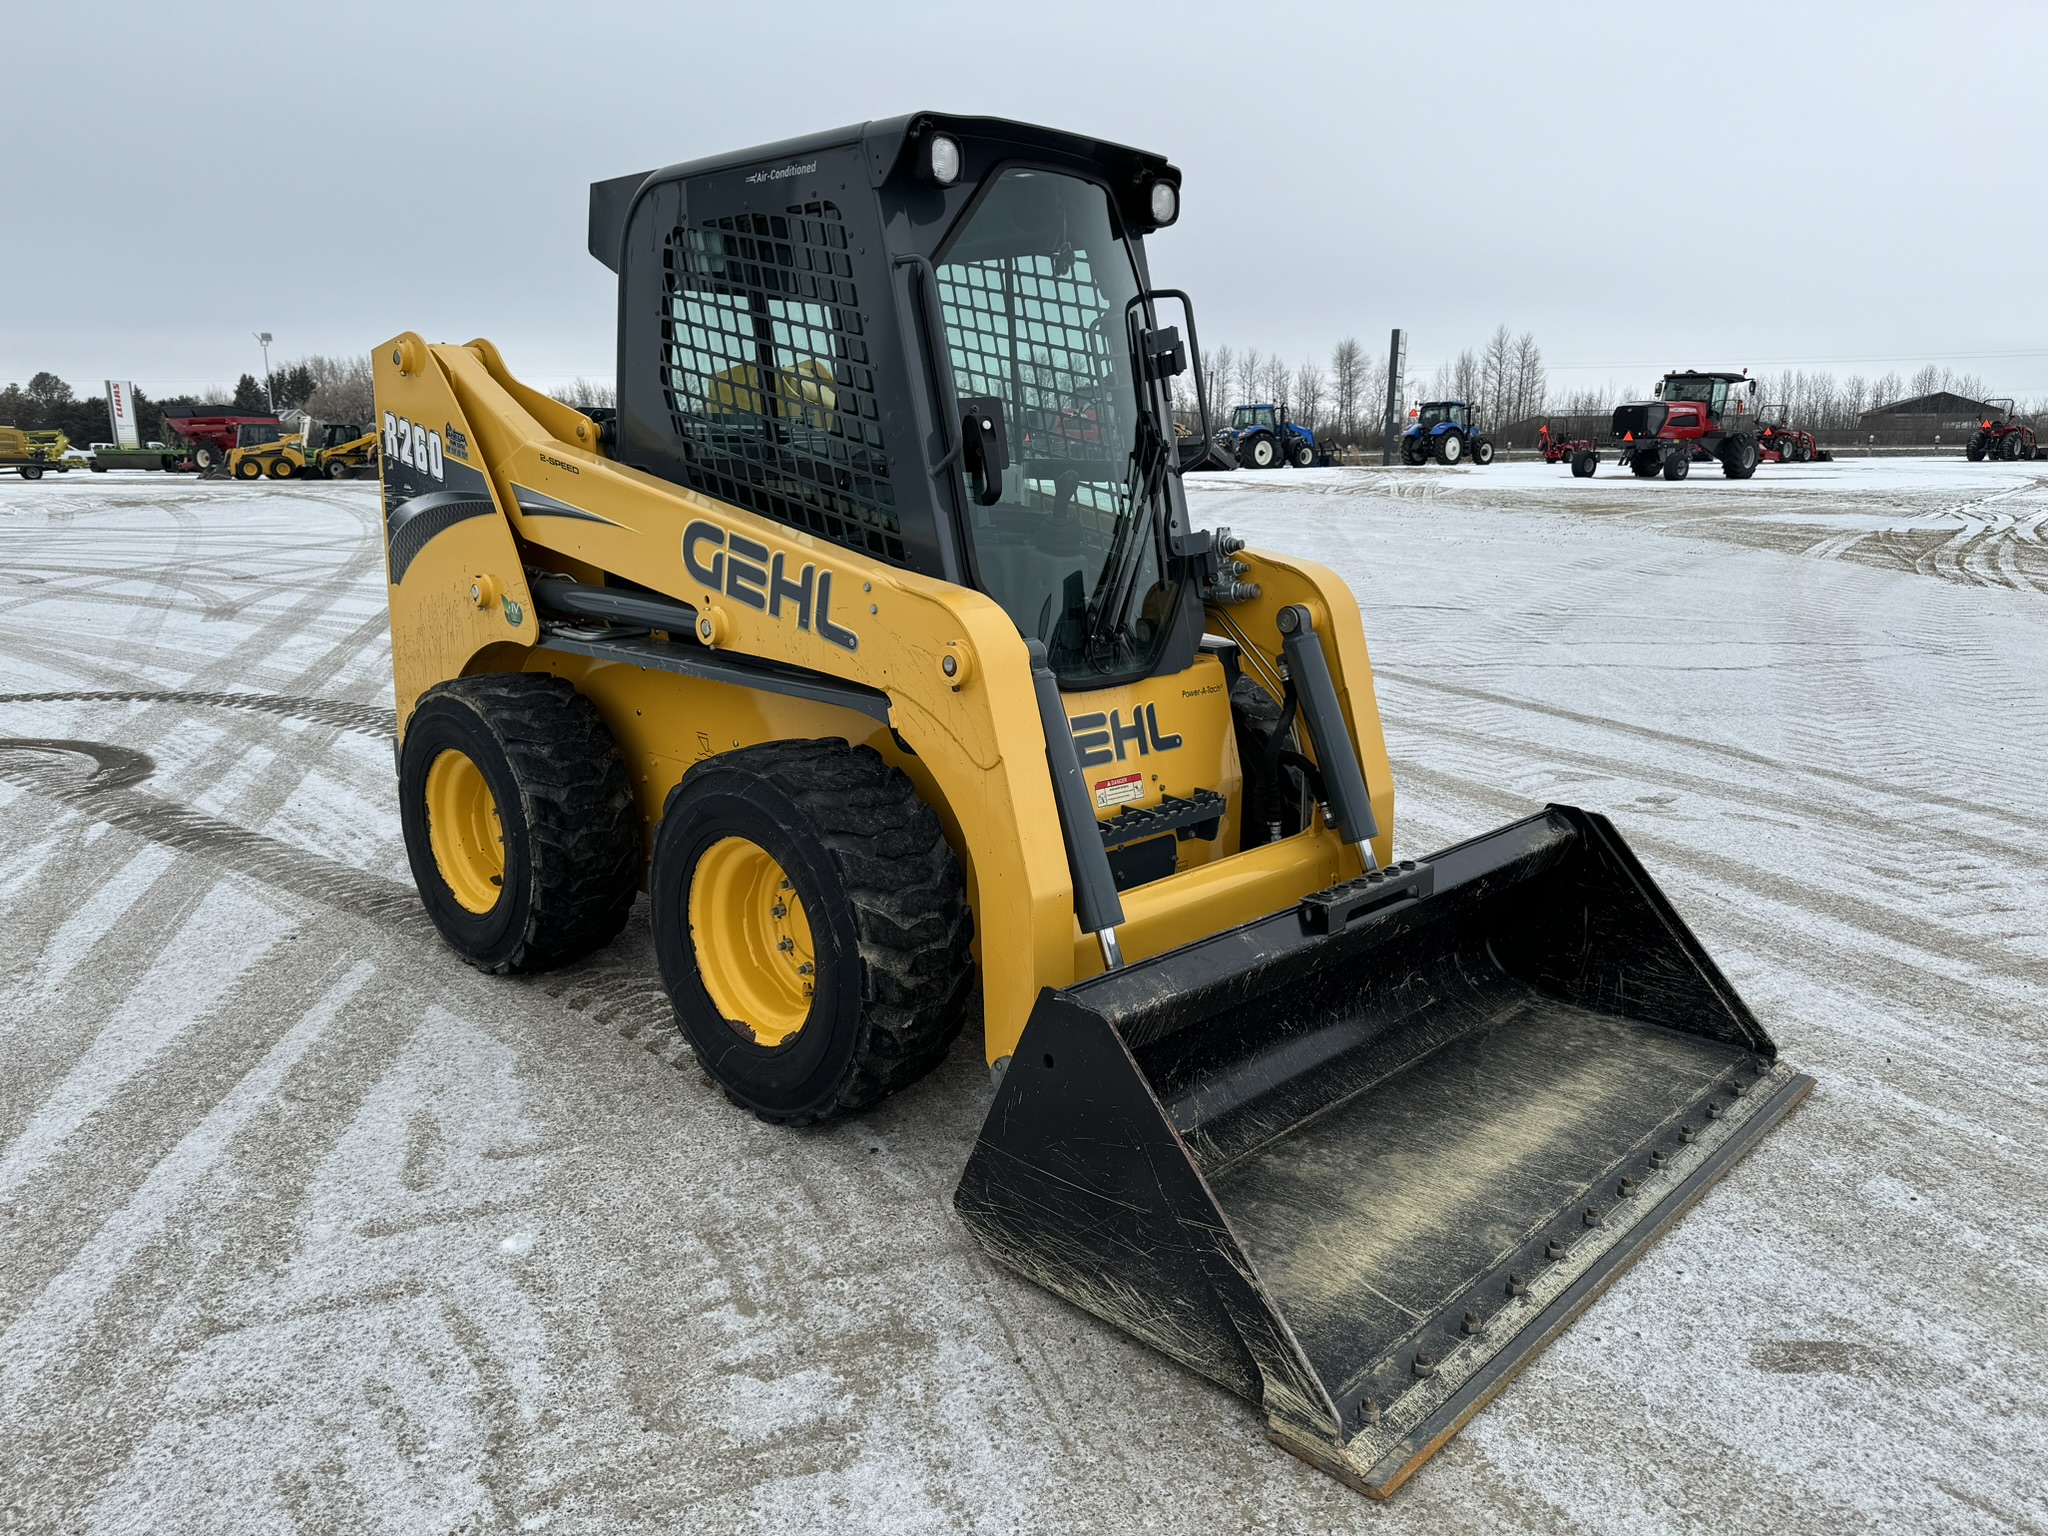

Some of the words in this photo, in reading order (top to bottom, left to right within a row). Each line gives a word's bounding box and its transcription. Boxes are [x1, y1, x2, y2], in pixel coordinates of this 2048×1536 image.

[756, 160, 817, 183] Air-Conditioned
[112, 382, 123, 418] CLAAS
[383, 409, 444, 482] R260
[539, 453, 580, 475] 2-SPEED
[682, 518, 859, 652] GEHL
[1068, 701, 1183, 769] EHL
[1111, 777, 1128, 786] DANGER
